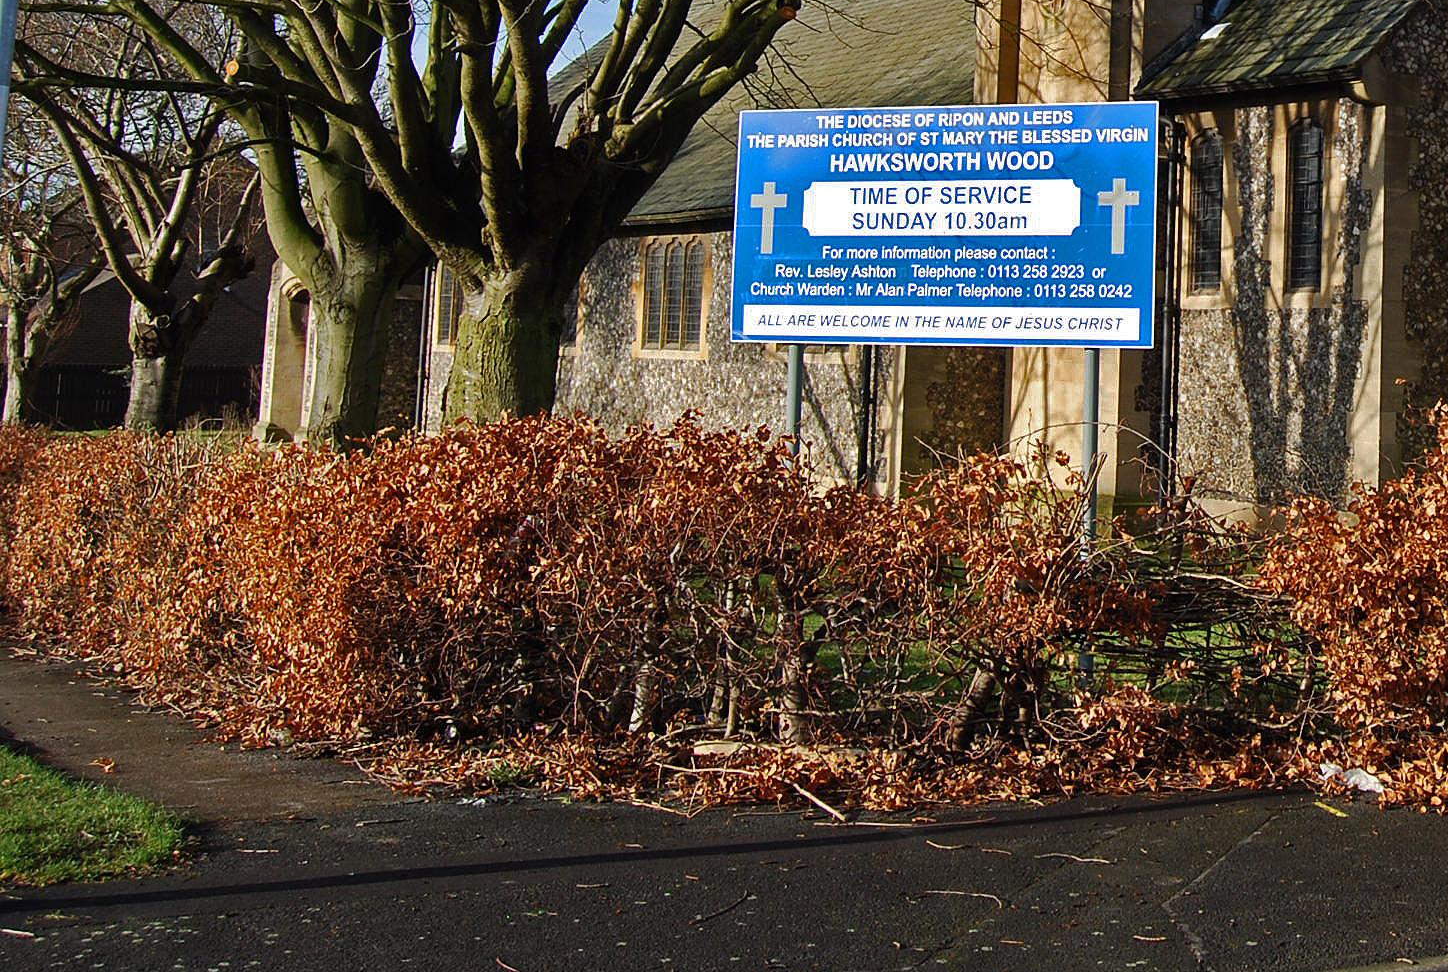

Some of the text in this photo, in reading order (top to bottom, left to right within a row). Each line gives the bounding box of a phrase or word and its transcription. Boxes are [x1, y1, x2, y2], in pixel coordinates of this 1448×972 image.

[816, 110, 1073, 129] THE DIOCESE OF RIPON AND LEEDS
[747, 128, 1148, 149] THE PARISH CHURCH OF ST MARY THE BLESSED VIRGIN
[830, 151, 1054, 172] HAWKSWORTH WOOD
[850, 186, 1031, 204] TIME OF SERVICE
[853, 212, 1027, 229] SUNDAY 10.30am
[823, 246, 843, 259] For
[847, 249, 877, 259] more
[881, 246, 950, 259] information
[954, 247, 996, 262] please
[1000, 247, 1048, 259] contact
[775, 264, 803, 277] Rev.
[808, 265, 848, 281] Lesley
[851, 265, 896, 278] Ashton
[911, 265, 976, 280] Telephone
[988, 265, 1019, 278] 0113
[1023, 265, 1047, 278] 258
[1051, 265, 1084, 278] 2923
[1092, 268, 1106, 278] or
[751, 282, 793, 295] Church
[797, 282, 844, 296] Warden
[856, 283, 873, 296] Mr
[876, 283, 904, 296] Alan
[907, 284, 953, 297] Palmer
[956, 284, 1022, 300] Telephone
[1034, 284, 1066, 297] 0113
[1069, 284, 1094, 298] 258
[1099, 285, 1132, 298] 0242
[758, 314, 1123, 330] ALL ARE WELCOME IN THE NAME OF JESUS CHRIST
